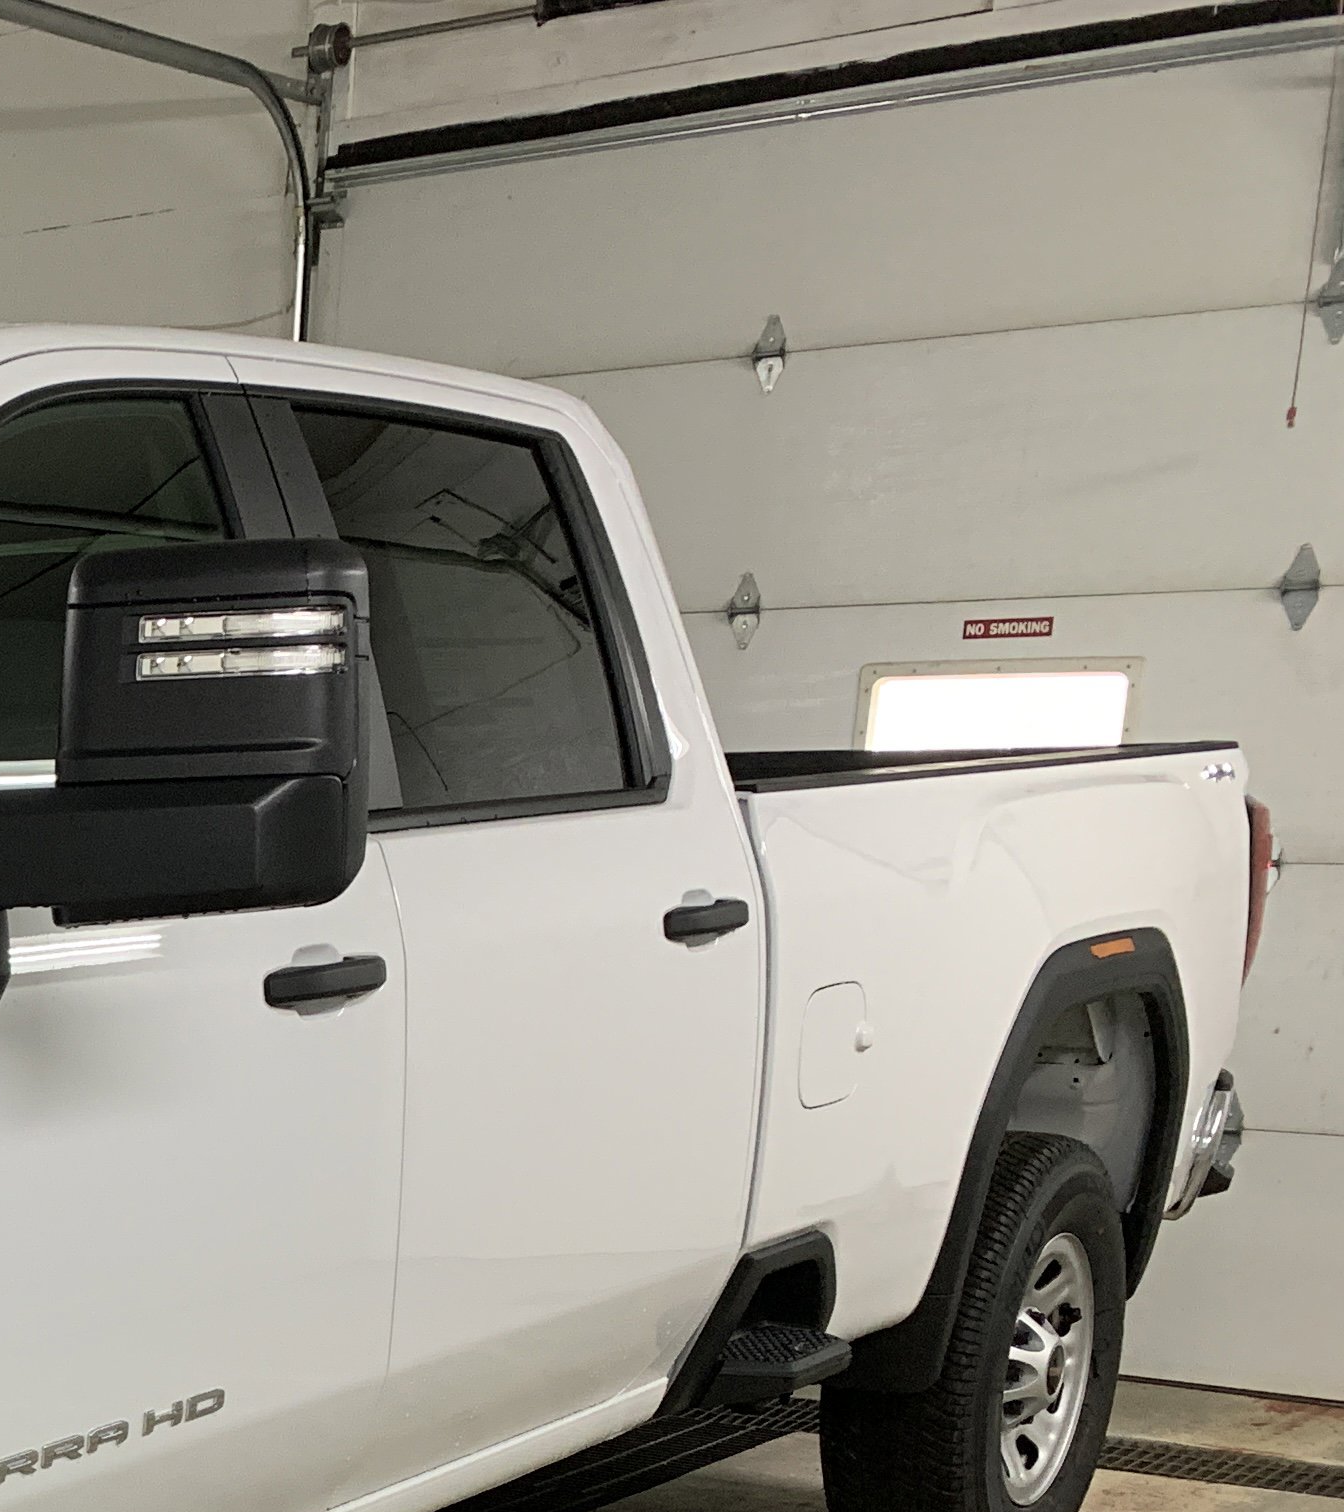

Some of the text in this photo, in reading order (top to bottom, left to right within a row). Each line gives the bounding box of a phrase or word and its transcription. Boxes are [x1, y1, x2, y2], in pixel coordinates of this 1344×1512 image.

[965, 620, 1050, 636] NO SMOKING
[141, 1387, 225, 1437] HD
